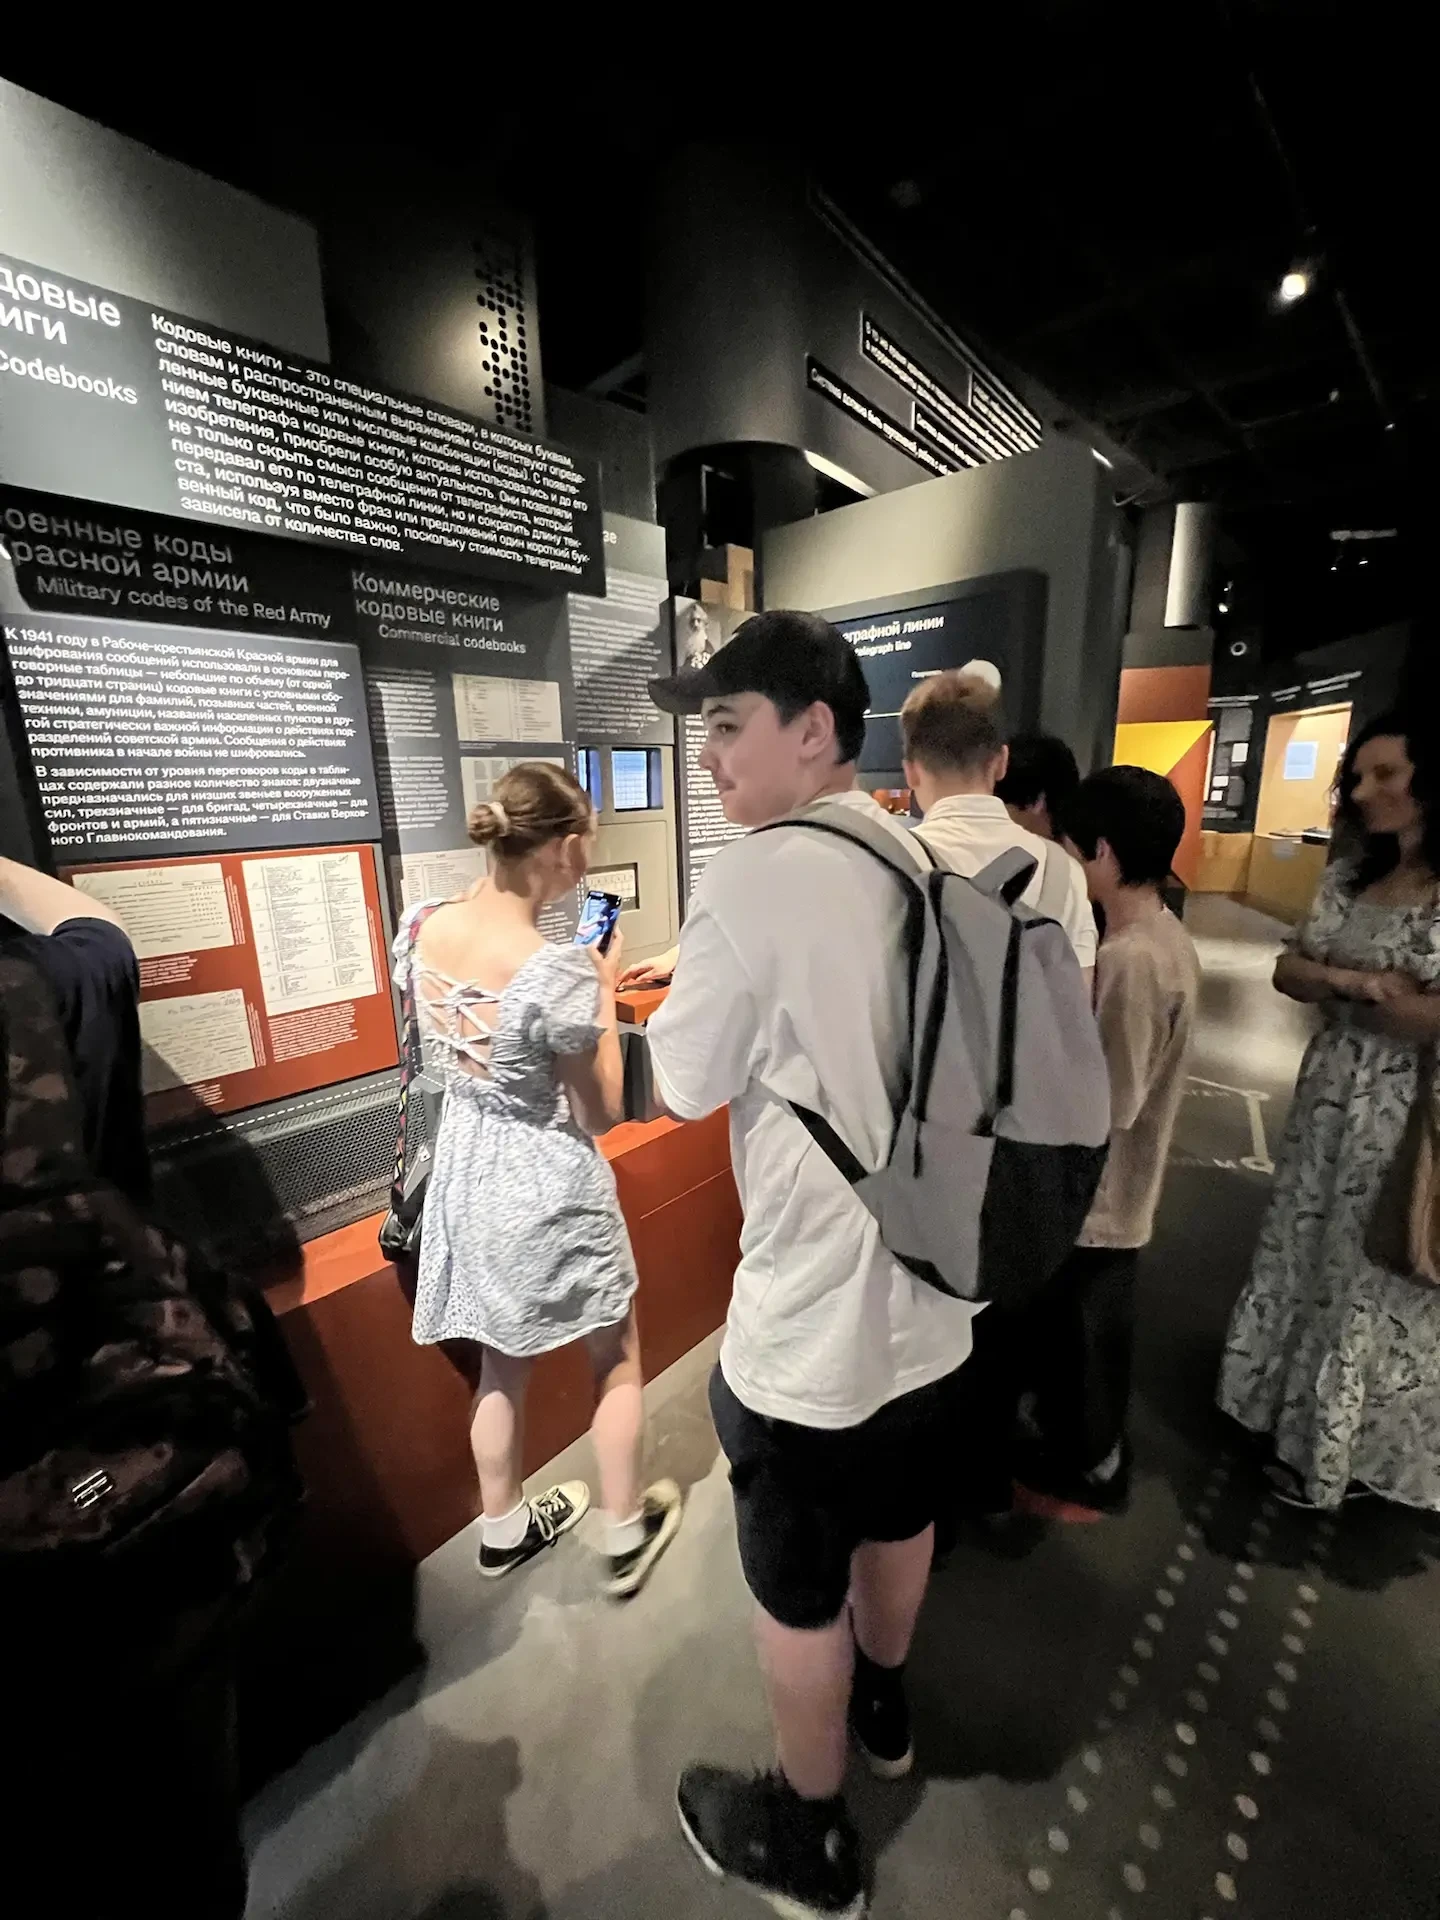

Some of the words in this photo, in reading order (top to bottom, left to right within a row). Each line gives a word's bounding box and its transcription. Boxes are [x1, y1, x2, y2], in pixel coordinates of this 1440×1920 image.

[152, 314, 232, 354] Кодовые
[236, 346, 282, 370] книги
[306, 370, 330, 386] это
[334, 379, 423, 417] специальные
[481, 428, 488, 438] в
[490, 432, 533, 454] которых
[156, 338, 224, 370] словам
[228, 361, 239, 375] и
[243, 366, 387, 421] распространенным
[390, 414, 470, 448] выражениям
[159, 359, 228, 390] ленные
[232, 379, 319, 417] буквенные
[323, 409, 349, 426] или
[352, 418, 417, 446] числовые
[420, 440, 490, 468] комбинации
[533, 472, 540, 484] С
[162, 379, 210, 403] нием
[212, 394, 300, 429] телеграфа
[303, 420, 364, 447] кодовые
[368, 440, 409, 462] книги,
[412, 453, 461, 475] которые
[464, 468, 549, 500] использовались
[559, 496, 571, 506] до
[573, 500, 587, 511] его
[166, 399, 279, 442] изобретения,
[283, 432, 361, 462] приобрели
[364, 455, 412, 476] особую
[499, 490, 520, 506] Они
[168, 418, 191, 435] не
[194, 426, 253, 451] только
[257, 443, 313, 466] скрыть
[317, 458, 364, 480] смысл
[367, 472, 438, 498] сообщения
[440, 492, 453, 502] от
[534, 516, 572, 532] который
[172, 438, 265, 472] передавал
[268, 463, 293, 478] его
[297, 470, 315, 484] по
[318, 475, 406, 506] телеграфной
[408, 498, 448, 518] линии,
[452, 510, 466, 520] но
[468, 513, 475, 522] и
[478, 516, 530, 536] сократить
[532, 529, 562, 546] длину
[175, 458, 210, 479] ста,
[215, 468, 300, 498] используя
[303, 489, 354, 510] вместо
[358, 499, 392, 518] фраз
[395, 510, 418, 524] или
[421, 516, 497, 542] предложений
[500, 535, 524, 548] один
[526, 541, 570, 558] короткий
[0, 507, 142, 549] оенные
[153, 533, 233, 564] коды
[178, 478, 244, 502] венный
[248, 493, 282, 513] код,
[285, 501, 311, 516] что
[314, 505, 351, 525] было
[354, 517, 400, 537] важно,
[404, 528, 466, 552] поскольку
[468, 542, 523, 562] стоимость
[524, 554, 582, 574] телеграммы
[181, 497, 263, 523] зависела
[265, 514, 282, 527] от
[285, 518, 367, 544] количества
[370, 536, 404, 552] слов.
[152, 562, 250, 593] армии
[352, 570, 501, 612] Коммерческие
[37, 575, 121, 605] Military
[128, 588, 188, 610] codes
[194, 596, 214, 612] of
[217, 598, 249, 617] the
[254, 601, 286, 621] Red
[290, 607, 331, 629] Army
[355, 599, 445, 625] кодовые
[452, 612, 504, 632] книги
[378, 624, 460, 647] Commercial
[463, 637, 527, 654] codebooks
[902, 616, 945, 633] линии
[4, 627, 18, 640] К
[20, 629, 53, 643] 1941
[56, 635, 88, 648] году
[91, 638, 100, 646] в
[102, 636, 235, 658] Рабоче-крестьянской
[237, 649, 284, 662] Красной
[8, 644, 103, 660] шифрования
[106, 652, 179, 667] сообщений
[182, 660, 261, 673] использовали
[895, 640, 912, 651] line
[12, 660, 82, 673] говорные
[85, 664, 143, 678] таблицы
[160, 669, 227, 683] небольшие
[15, 675, 34, 686] до
[36, 676, 102, 689] тридцати
[105, 681, 163, 693] страниц)
[166, 684, 217, 695] кодовые
[18, 690, 106, 702] значениями
[109, 694, 133, 704] для
[135, 693, 196, 708] фамилий,
[20, 704, 84, 716] техники,
[86, 707, 156, 719] амуниции,
[157, 709, 214, 720] названий
[25, 717, 50, 728] гой
[53, 720, 150, 731] стратегически
[154, 722, 200, 732] важной
[28, 732, 112, 744] разделений
[114, 734, 178, 744] советской
[224, 735, 287, 746] Сообщения
[31, 748, 114, 758] противника
[116, 748, 125, 756] в
[127, 748, 172, 757] начале
[174, 747, 212, 757] войны
[35, 766, 47, 777] В
[50, 768, 142, 777] зависимости
[144, 768, 159, 776] от
[161, 768, 205, 778] уровня
[208, 768, 279, 777] переговоров
[39, 782, 65, 792] цах
[68, 781, 144, 792] содержали
[147, 780, 191, 791] разное
[194, 779, 260, 788] количество
[42, 794, 163, 806] предназначались
[166, 793, 188, 802] для
[191, 792, 236, 800] низших
[44, 809, 75, 818] сил,
[77, 806, 164, 819] трехзначные
[182, 805, 204, 814] для
[48, 821, 108, 833] фронтов
[123, 816, 169, 830] армий,
[171, 818, 180, 826] а
[182, 814, 257, 825] пятизначные
[51, 836, 84, 845] ного
[86, 828, 226, 843] Главнокомандования.
